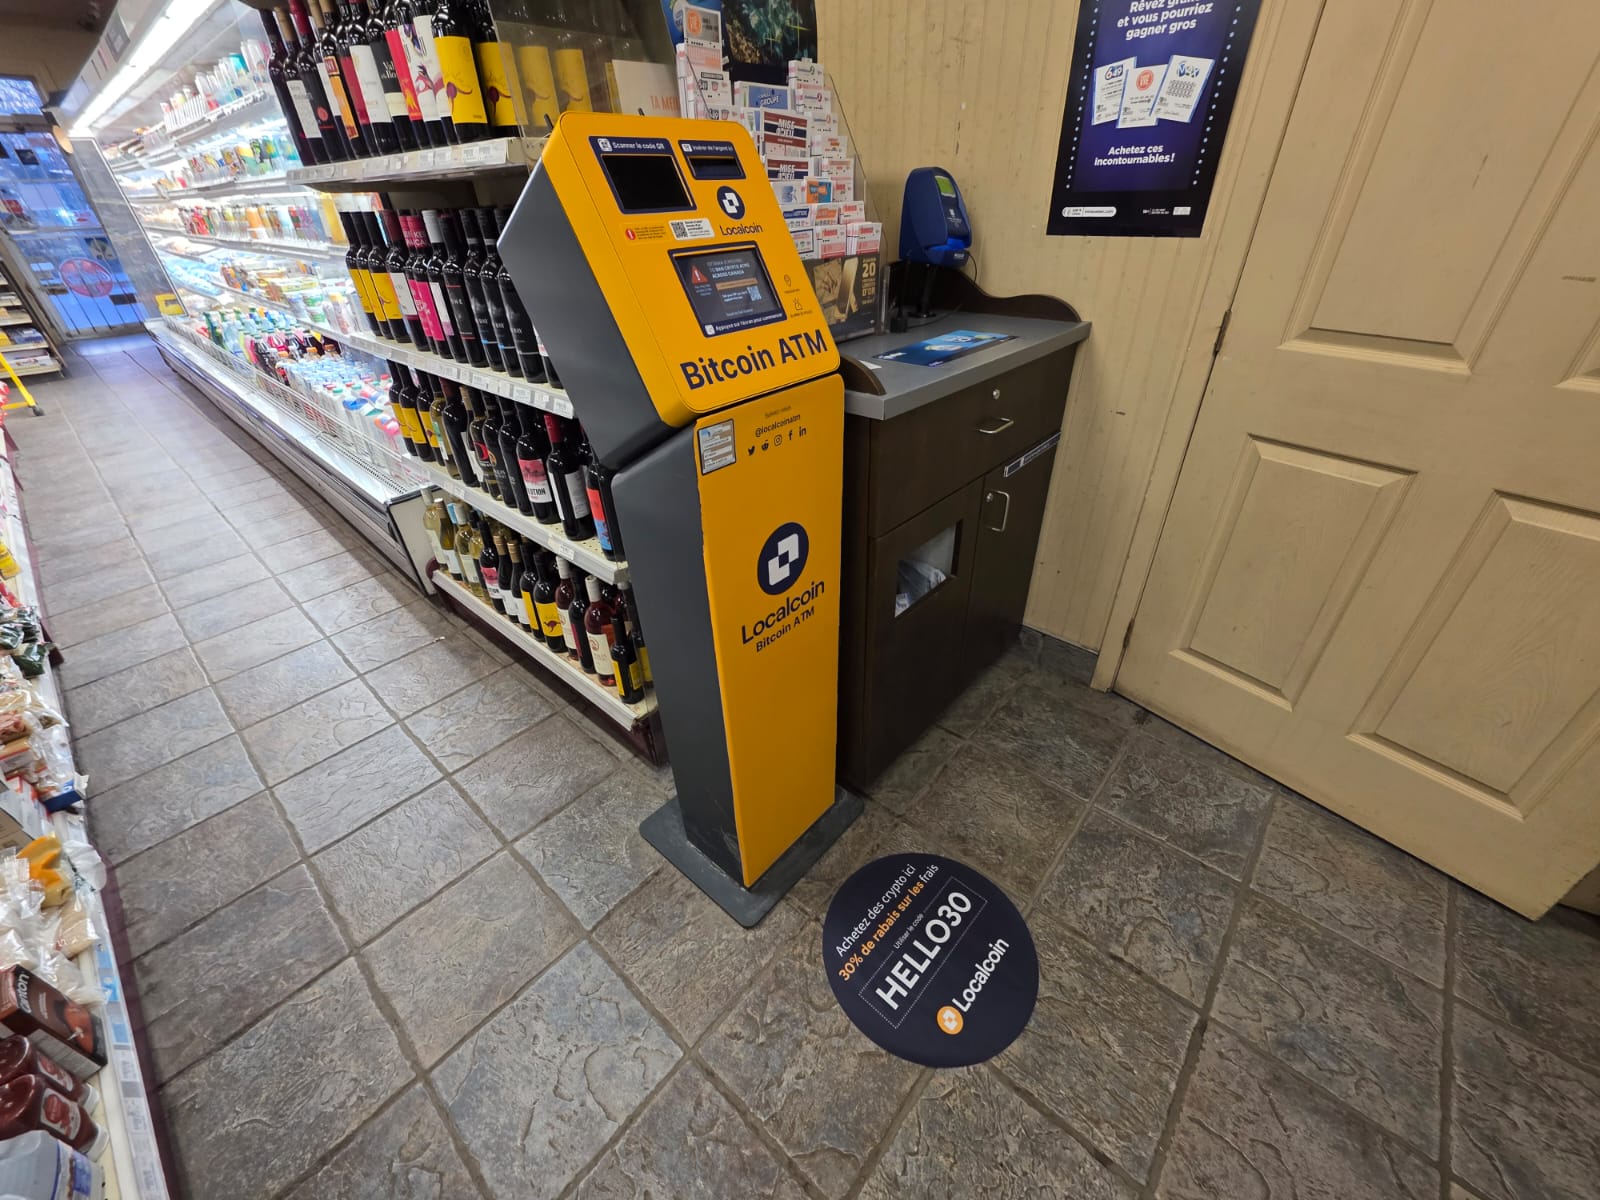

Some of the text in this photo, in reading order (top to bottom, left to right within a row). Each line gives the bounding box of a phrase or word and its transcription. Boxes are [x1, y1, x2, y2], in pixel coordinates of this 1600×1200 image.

[1117, 2, 1214, 28] et vous pourriez
[1129, 0, 1165, 13] Rêvez
[1125, 19, 1197, 40] gagner gros
[612, 141, 636, 149] Scanner
[1108, 145, 1164, 156] Achetez ces
[719, 221, 764, 236] Localcoin
[862, 262, 876, 278] 20
[680, 329, 829, 390] Bitcoin ATM
[755, 414, 801, 438] @localcoinatm
[741, 580, 825, 645] Localcoin
[756, 606, 815, 653] Bitcoin ATM
[835, 863, 917, 957] Achetez des crypto ici
[838, 864, 940, 981] 30% de rabais sur les frais
[875, 892, 972, 1011] HELLO30
[952, 938, 1010, 1012] Localcoin
